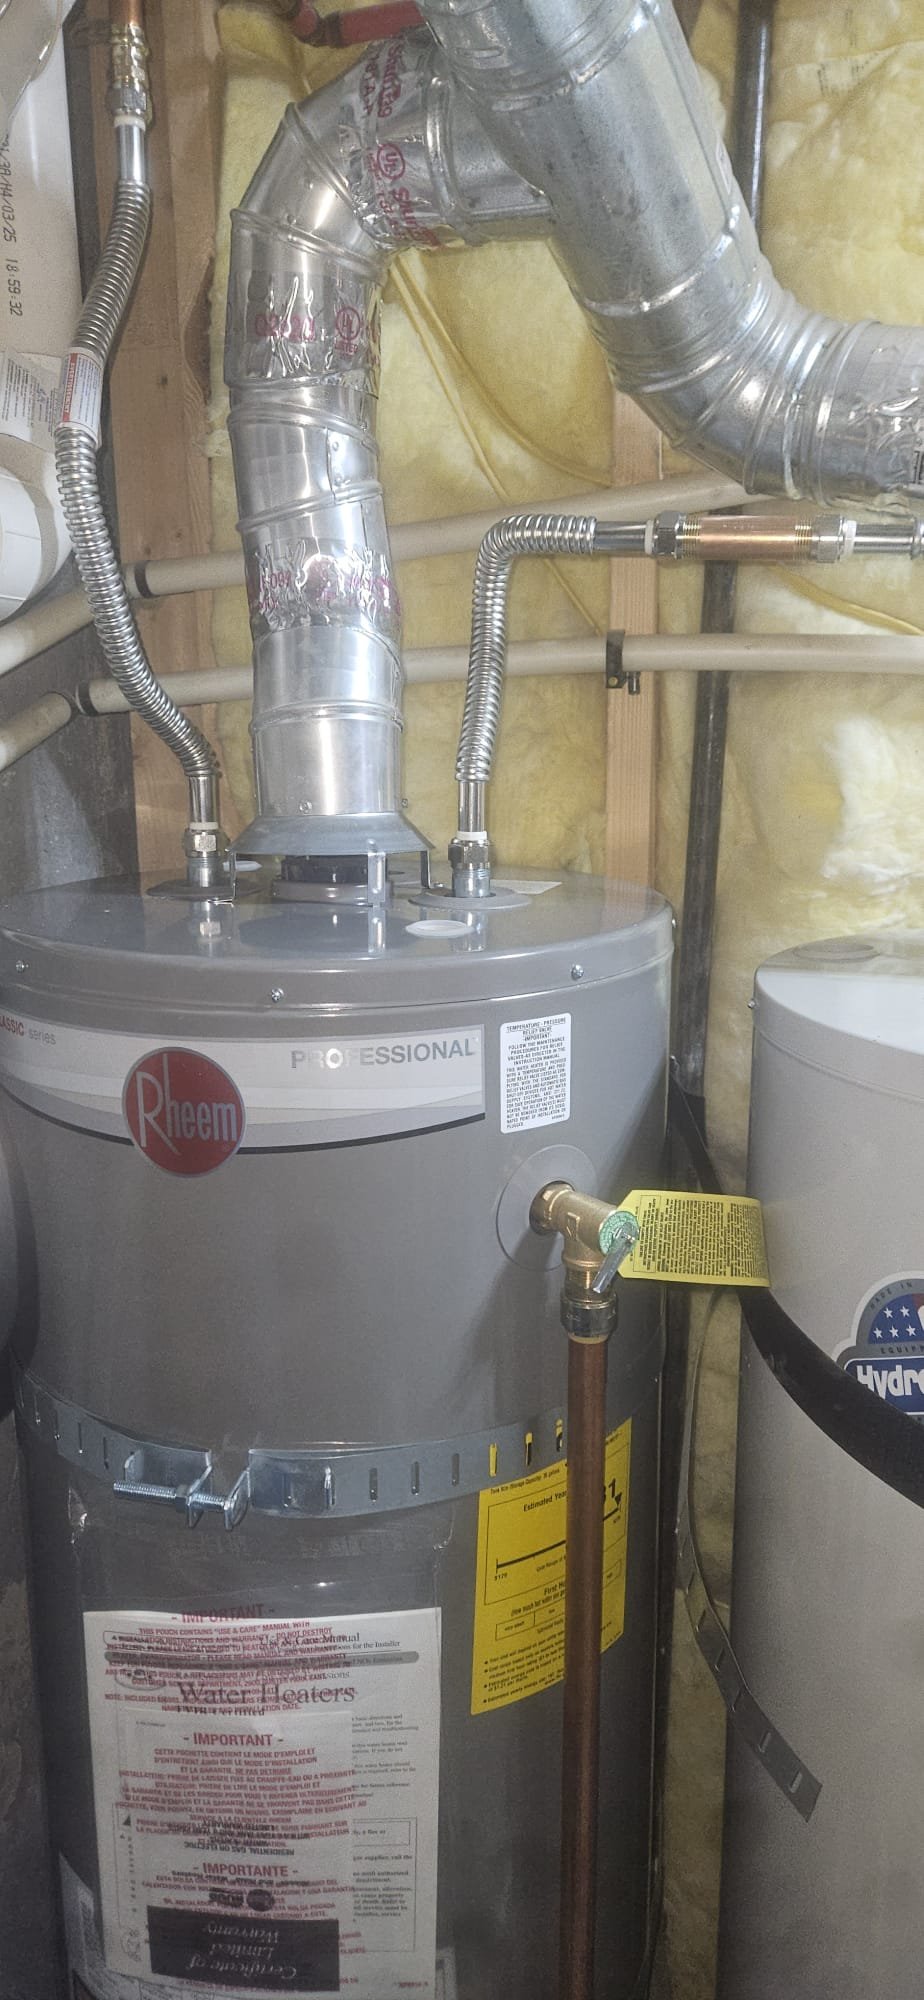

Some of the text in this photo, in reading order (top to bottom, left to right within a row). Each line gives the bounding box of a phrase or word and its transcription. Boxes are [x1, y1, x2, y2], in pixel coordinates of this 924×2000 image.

[6, 258, 23, 318] 18:59:32
[291, 1038, 475, 1069] PROFESSIONAL
[136, 1053, 238, 1156] Rheem
[523, 1490, 568, 1513] Estimated Year
[181, 1603, 265, 1624] IMPORTANT
[262, 1623, 290, 1631] MANUAL
[375, 1640, 401, 1648] Installer
[177, 1680, 249, 1704] Water
[261, 1683, 357, 1704] Heaters
[193, 1732, 273, 1746] IMPORTANT
[203, 1862, 289, 1877] IMPORTANTE
[208, 1943, 276, 1960] Limited
[185, 1956, 298, 1980] Certificate of
